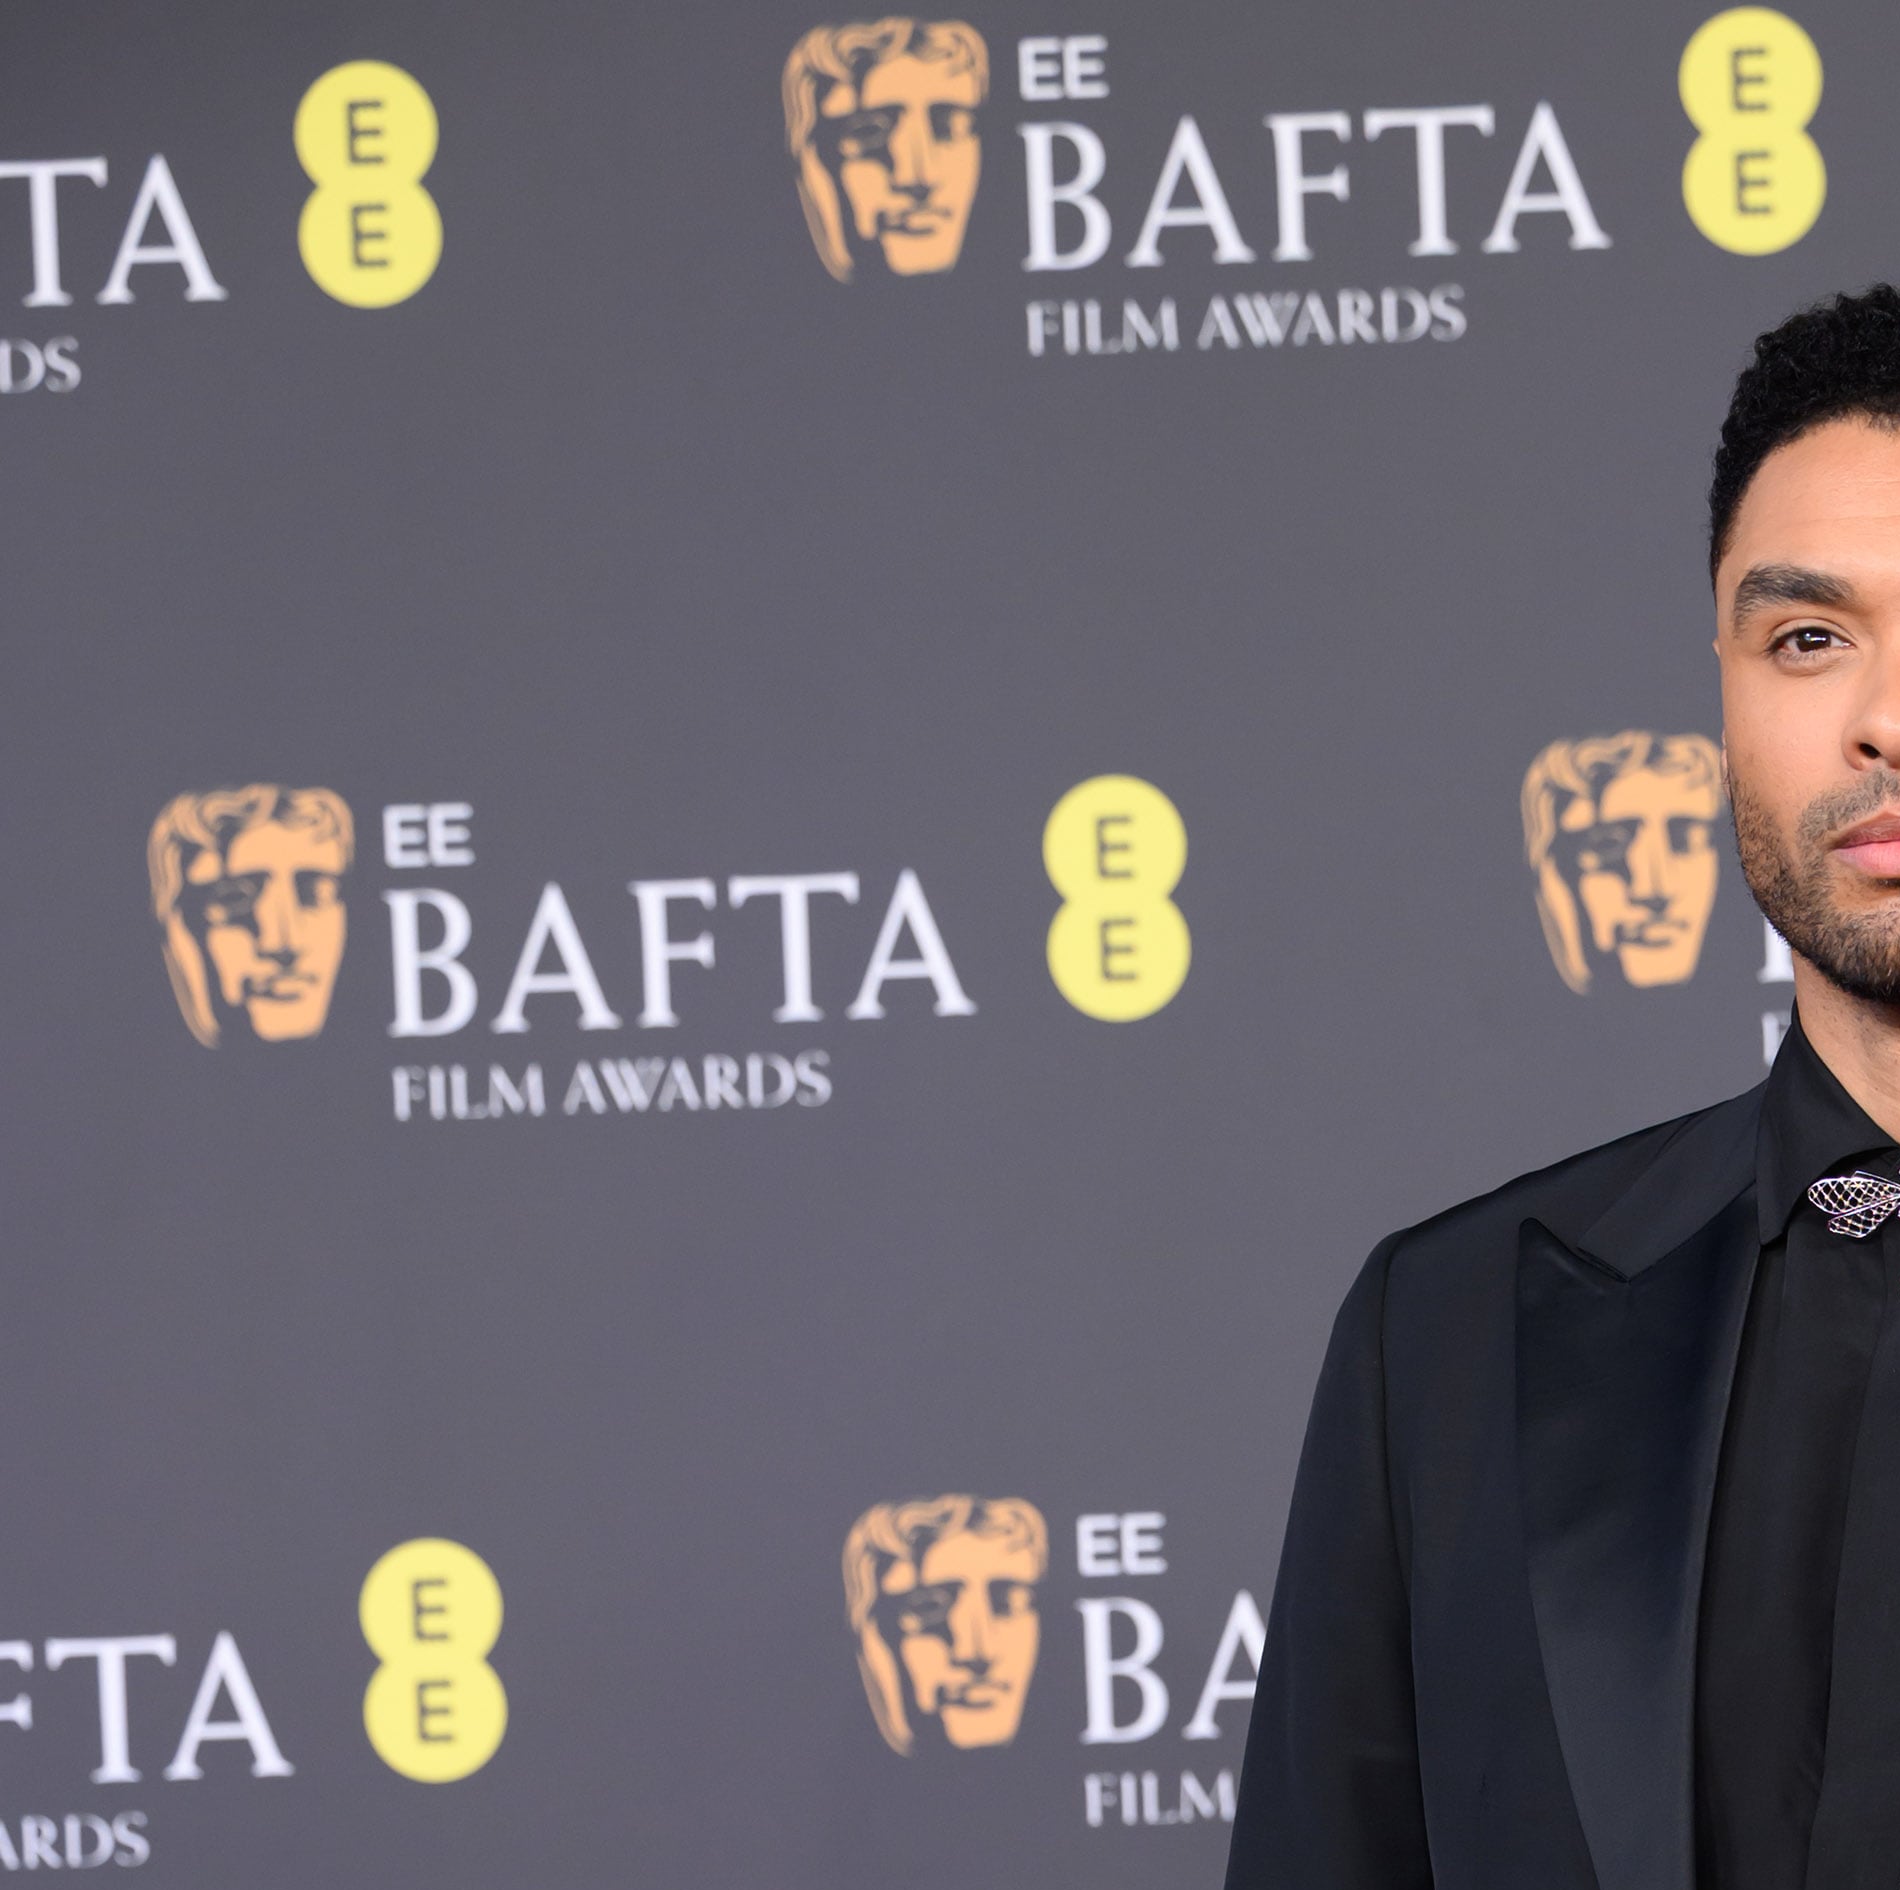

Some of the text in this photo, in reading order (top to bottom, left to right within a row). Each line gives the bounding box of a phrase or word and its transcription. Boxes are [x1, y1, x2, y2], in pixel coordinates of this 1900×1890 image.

[1018, 35, 1109, 101] EE
[1018, 102, 1612, 272] BAFTA
[1026, 285, 1467, 356] FILM AWARDS
[382, 802, 475, 868] EE
[383, 869, 977, 1038] BAFTA
[392, 1051, 832, 1121] FILM AWARDS
[1076, 1512, 1167, 1577] EE
[1083, 1769, 1237, 1829] FILM
